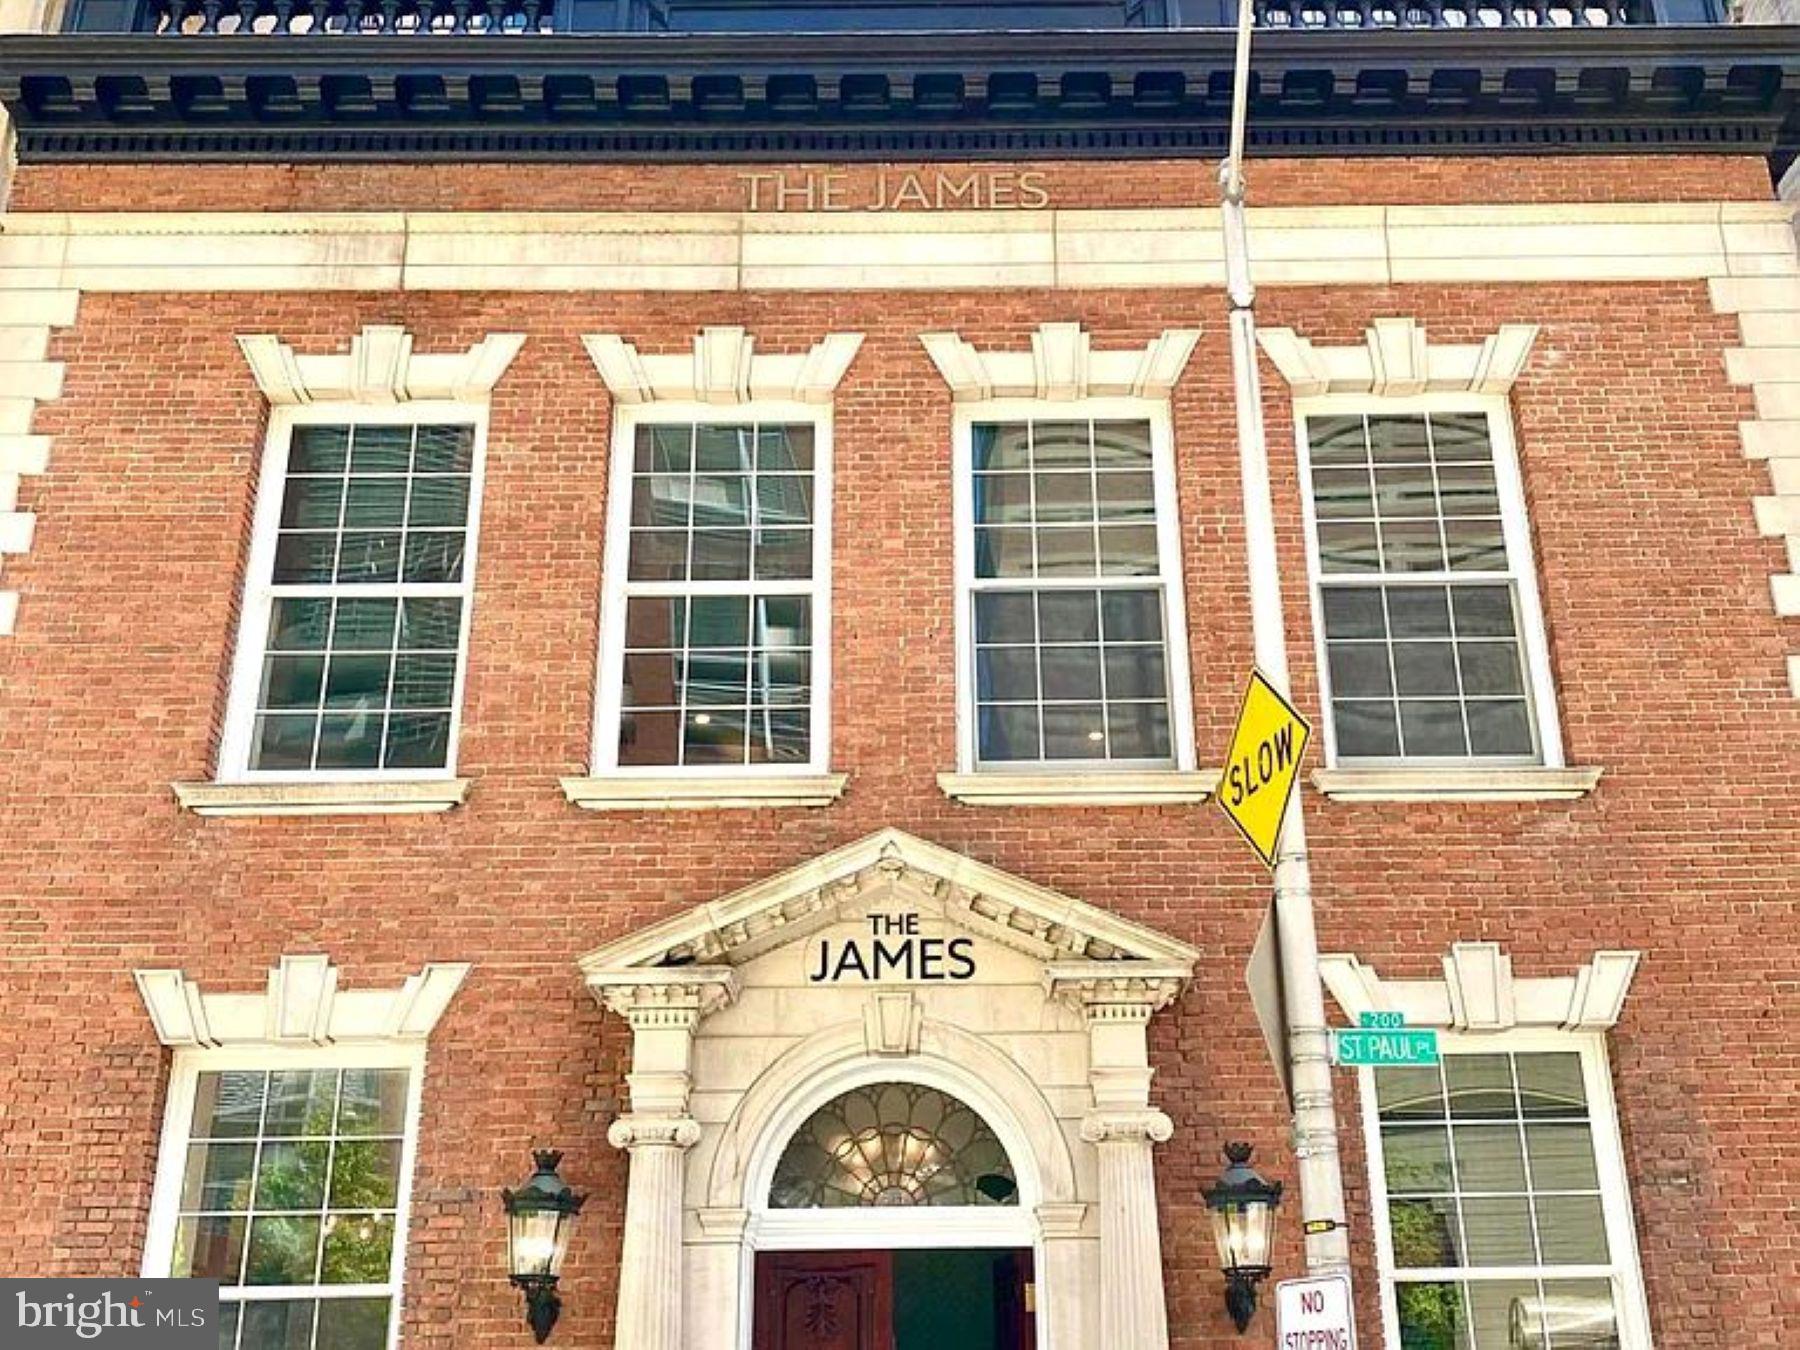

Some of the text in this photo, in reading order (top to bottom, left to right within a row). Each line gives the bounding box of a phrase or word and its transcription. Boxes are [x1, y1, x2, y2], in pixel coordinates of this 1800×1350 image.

[738, 172, 1049, 211] THE JAMES
[1229, 722, 1294, 806] SLOW
[866, 912, 919, 935] THE
[810, 938, 976, 982] JAMES
[1341, 1035, 1436, 1060] ST PAUL PL
[1301, 1290, 1324, 1314] NO
[1286, 1326, 1347, 1350] STOPPING
